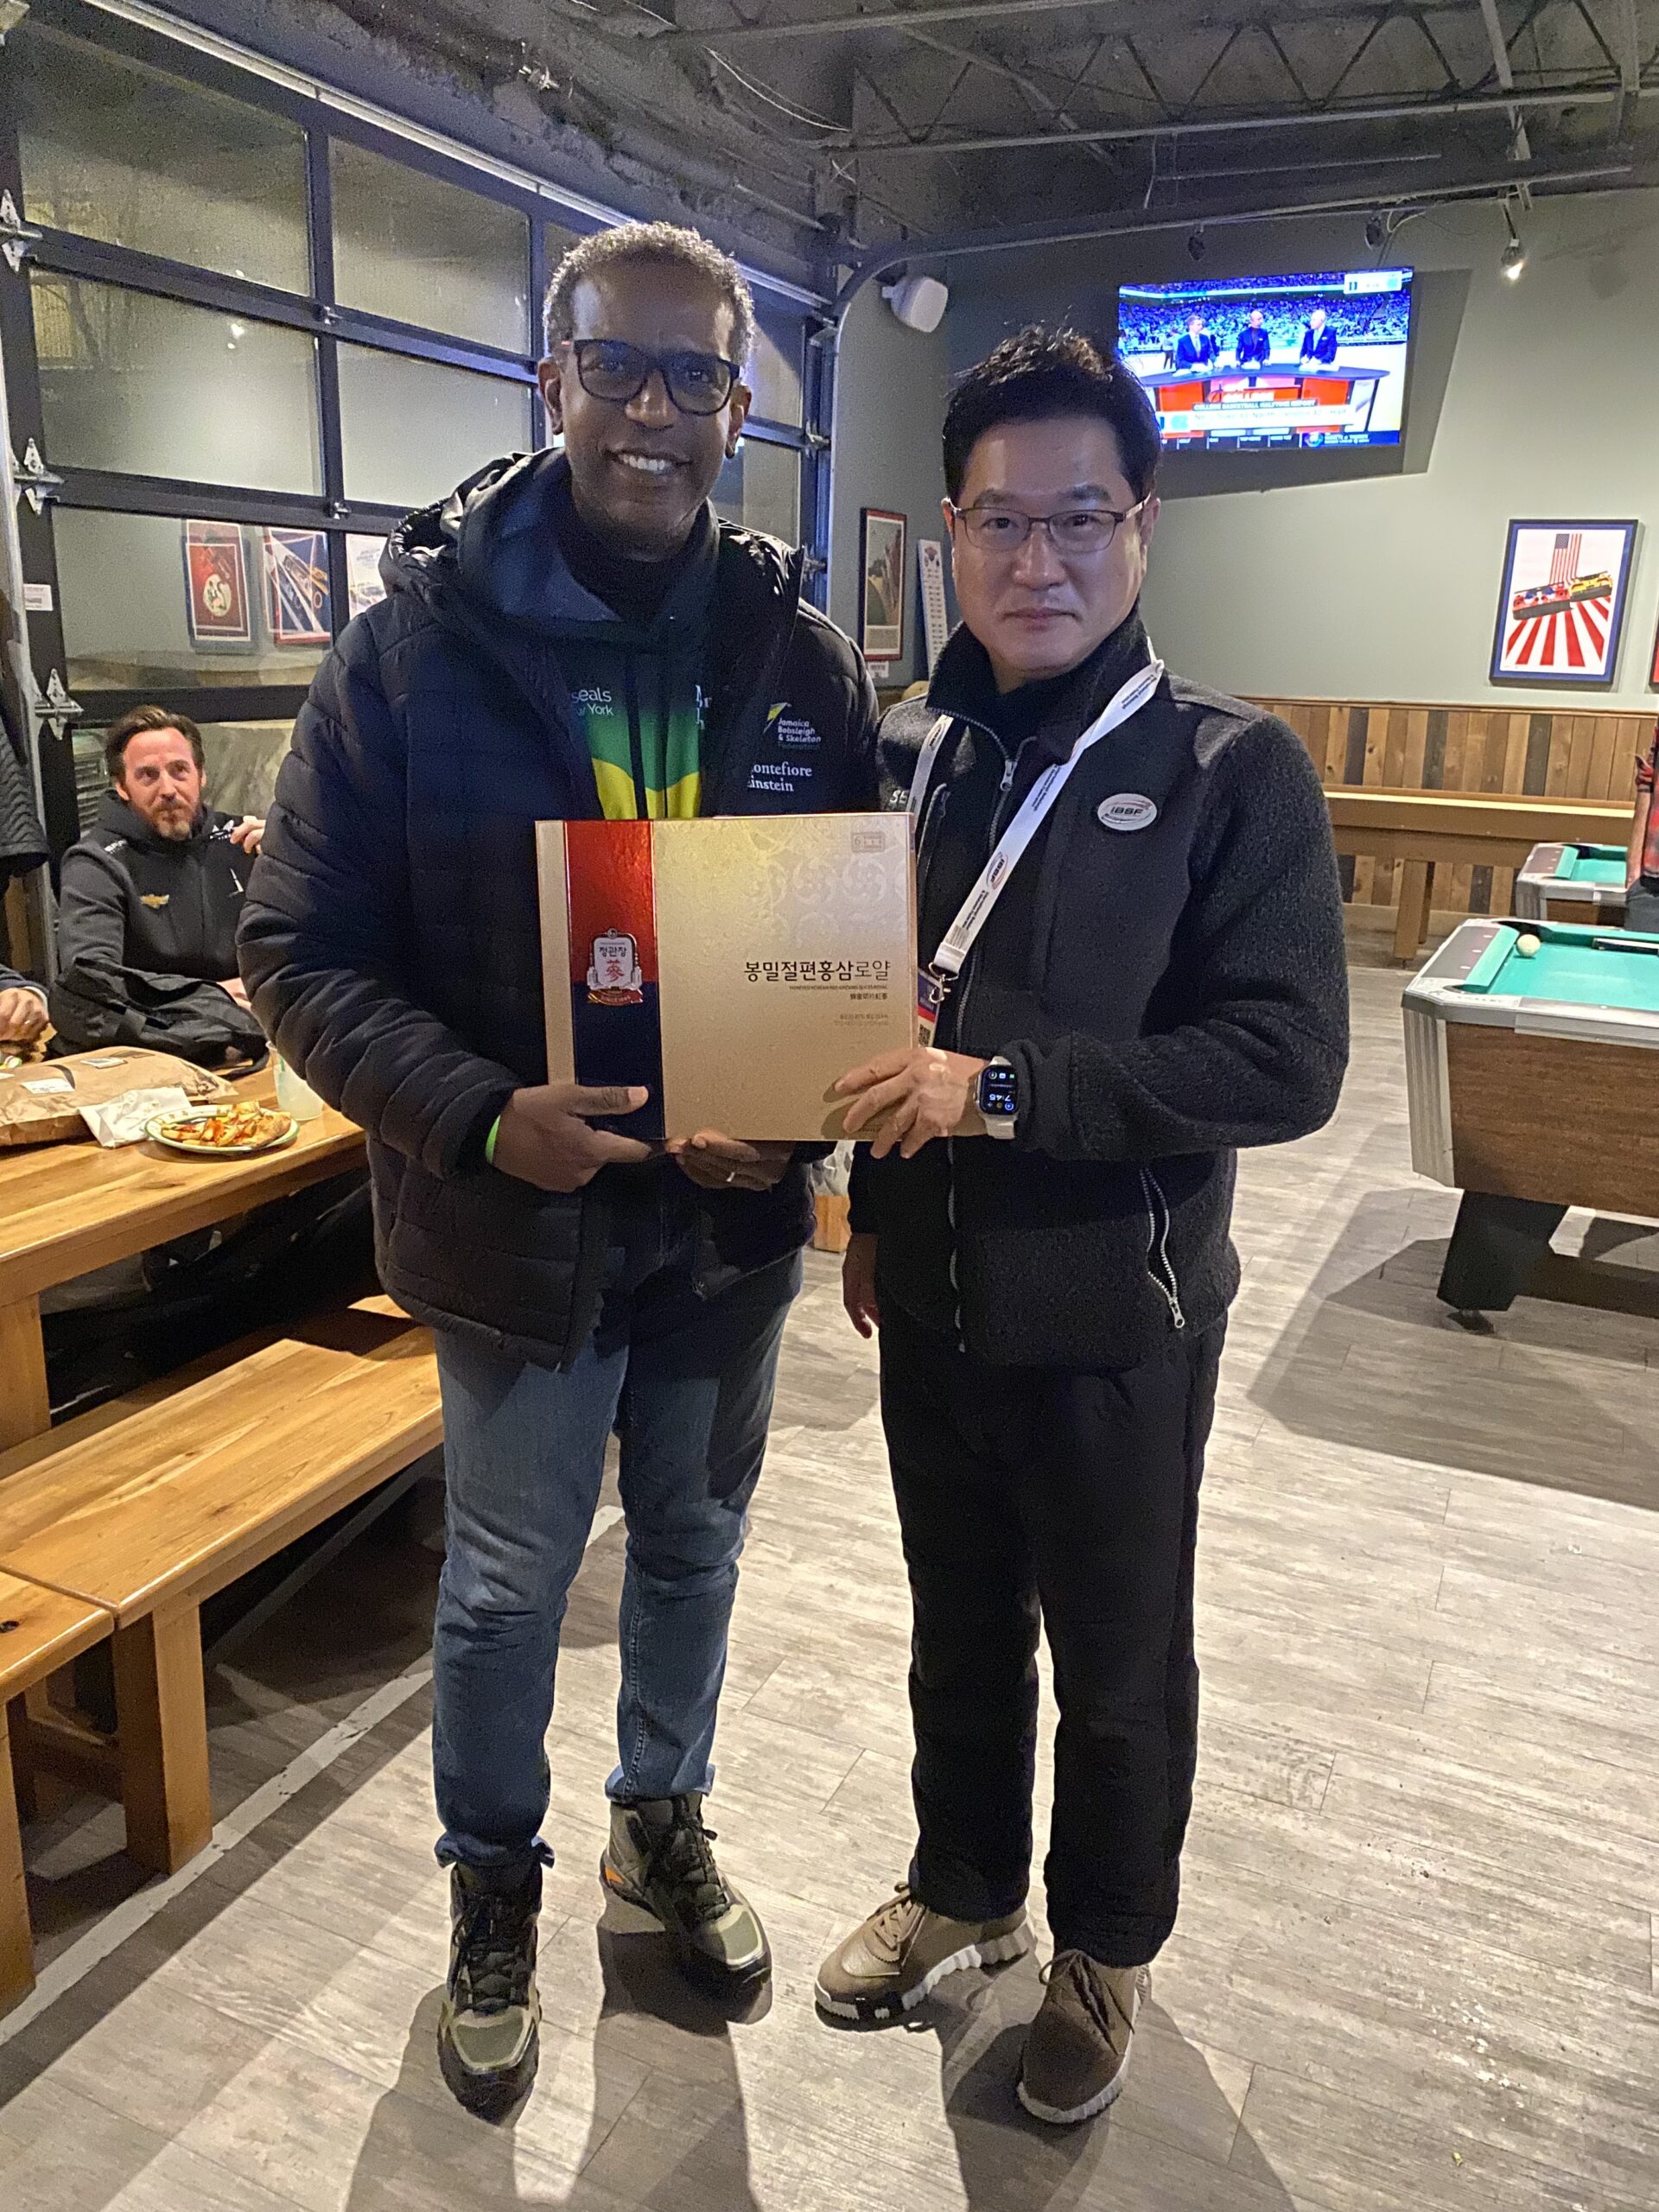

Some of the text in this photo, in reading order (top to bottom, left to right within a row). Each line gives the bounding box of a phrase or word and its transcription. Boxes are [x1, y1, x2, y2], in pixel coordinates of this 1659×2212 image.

[587, 702, 614, 716] York
[778, 717, 810, 727] Jamaica
[778, 726, 815, 736] Bobsleigh
[786, 734, 822, 742] Skeleton
[752, 761, 812, 777] ontefiore
[1110, 806, 1144, 817] IBSF
[991, 858, 1005, 882] IBSF
[599, 946, 627, 957] 정관장
